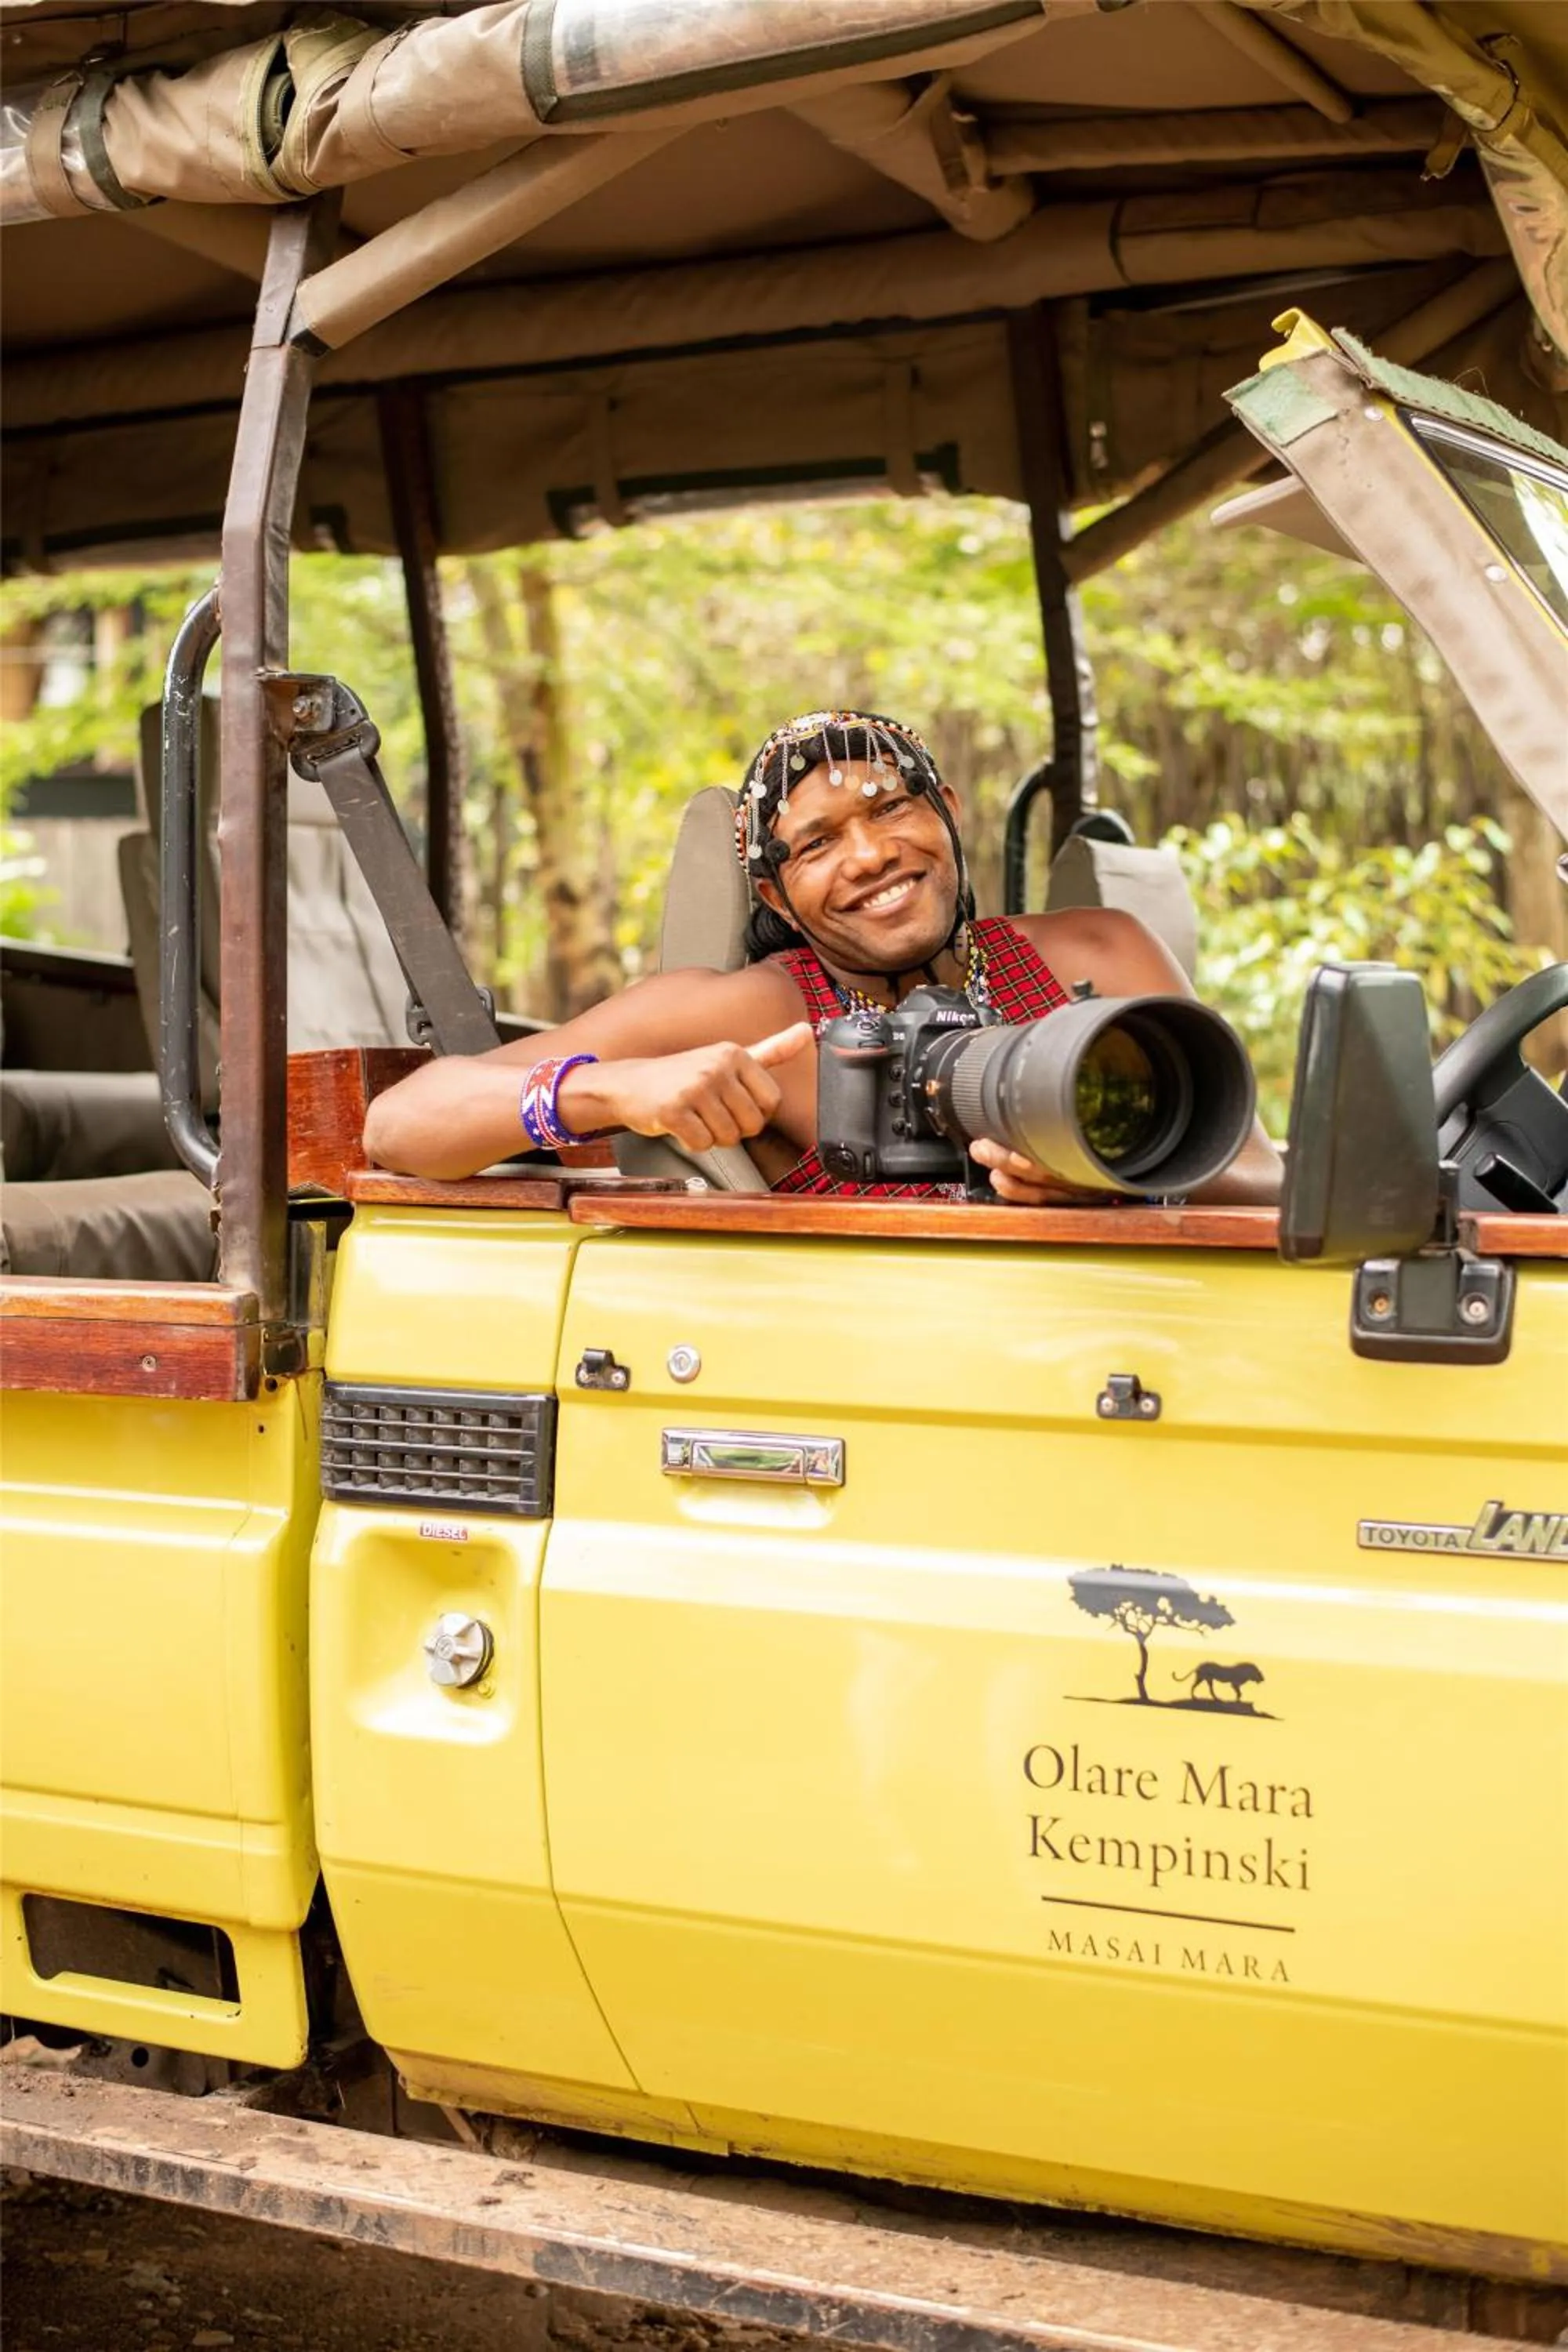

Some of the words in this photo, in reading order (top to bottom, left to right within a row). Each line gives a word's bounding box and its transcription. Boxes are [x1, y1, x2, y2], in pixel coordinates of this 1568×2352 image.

[936, 1010, 976, 1025] Nikon
[422, 1523, 466, 1540] DIESEL
[1363, 1526, 1461, 1548] TOYOTA
[1023, 1744, 1159, 1800] Olare
[1178, 1761, 1314, 1818] Mara
[1027, 1814, 1311, 1891] Kempinski
[1047, 1929, 1163, 1965] MASAI
[1181, 1947, 1290, 1983] MARA
